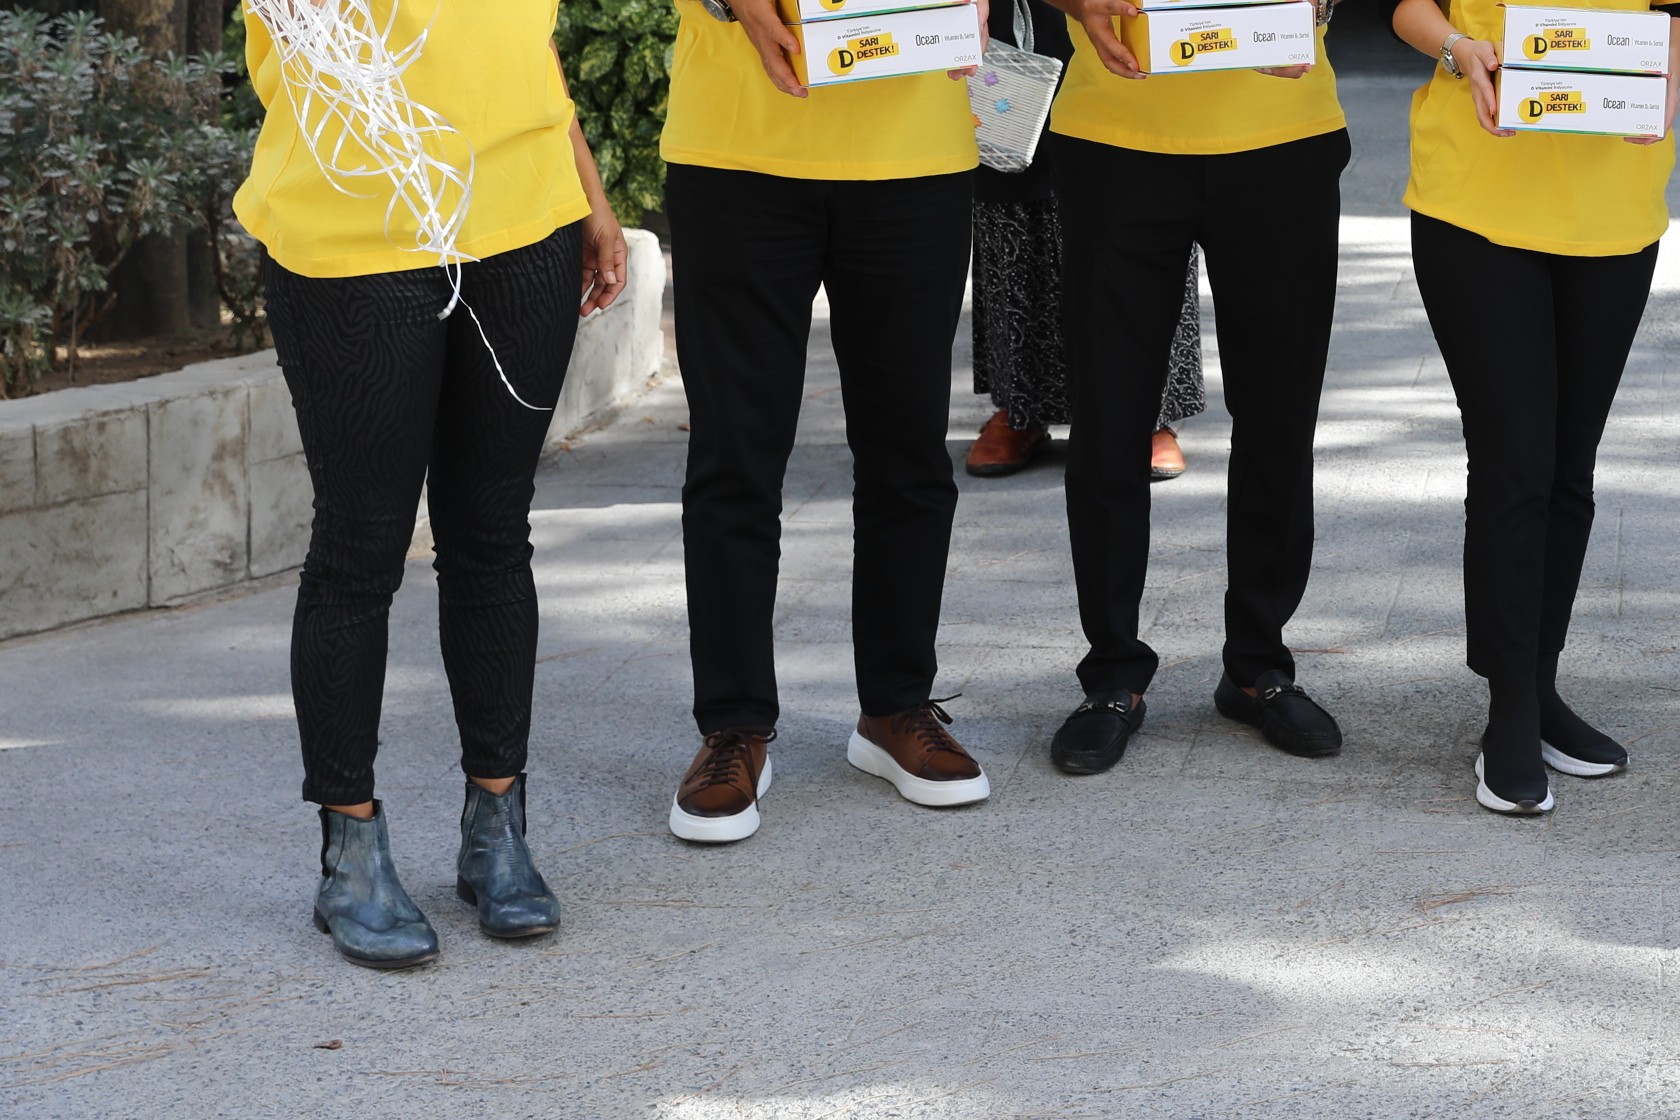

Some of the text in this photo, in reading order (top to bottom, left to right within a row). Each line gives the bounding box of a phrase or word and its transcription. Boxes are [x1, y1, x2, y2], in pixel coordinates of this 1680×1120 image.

[916, 35, 939, 46] Ocean
[1201, 32, 1218, 41] SARI
[1254, 32, 1275, 42] Ocean
[1608, 35, 1629, 46] Ocean
[859, 37, 878, 48] SARI
[1198, 40, 1232, 51] DESTEK!
[1534, 37, 1547, 54] D
[857, 45, 894, 59] DESTEK!
[1180, 42, 1194, 59] D
[838, 50, 854, 68] D
[1529, 101, 1543, 117] D
[1603, 98, 1625, 109] Ocean
